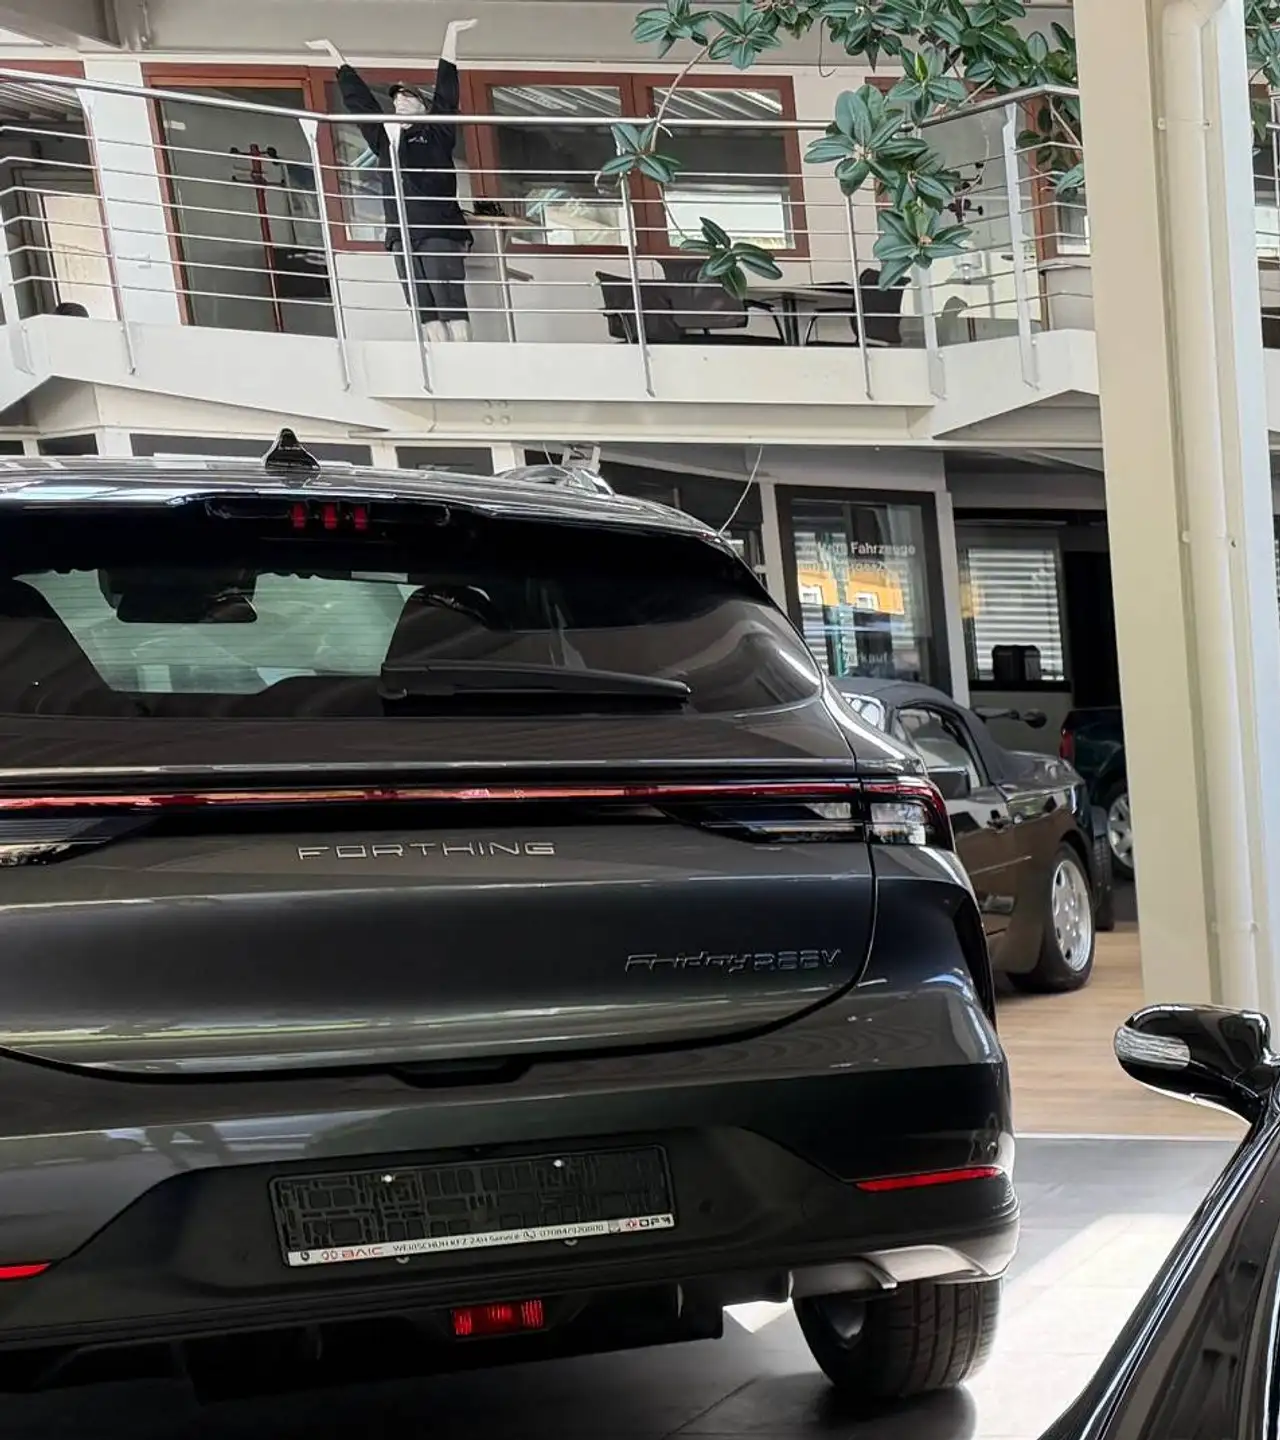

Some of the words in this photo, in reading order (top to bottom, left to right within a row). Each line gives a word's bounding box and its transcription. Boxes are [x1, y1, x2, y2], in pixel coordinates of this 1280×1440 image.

[850, 541, 917, 558] Fahrzeuge
[298, 842, 555, 860] FORTHING
[342, 1246, 384, 1259] BAIC
